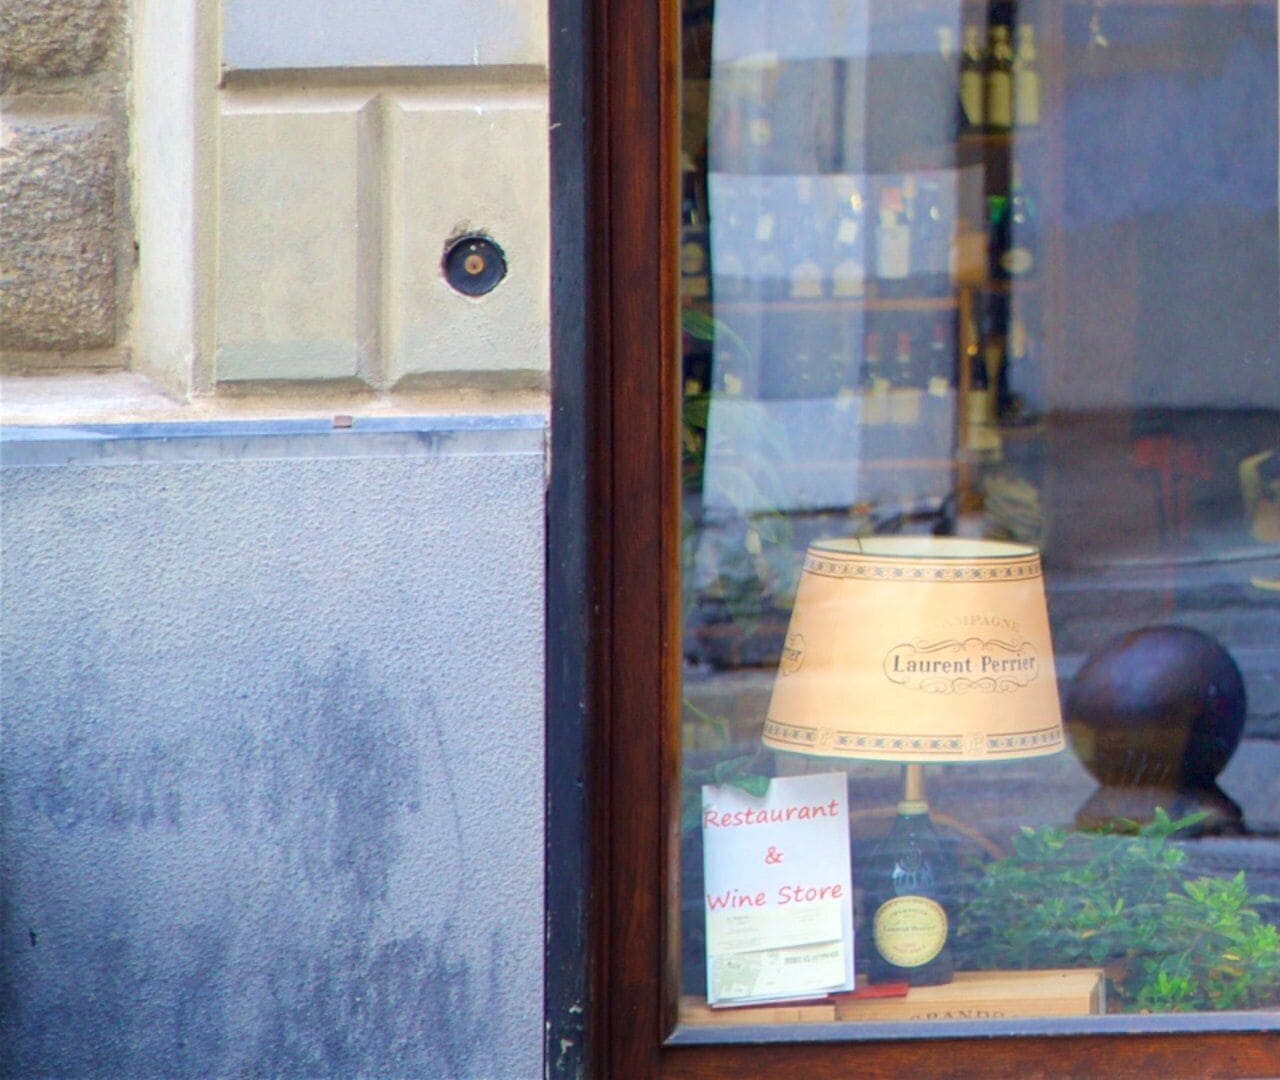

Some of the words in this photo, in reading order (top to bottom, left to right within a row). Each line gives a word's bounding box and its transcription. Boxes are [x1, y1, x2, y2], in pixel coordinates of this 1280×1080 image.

[893, 654, 973, 674] Laurent
[981, 653, 1036, 674] Perrier
[702, 799, 840, 829] Restaurant
[764, 845, 784, 864] &
[706, 888, 766, 911] Wine
[777, 883, 844, 905] Store
